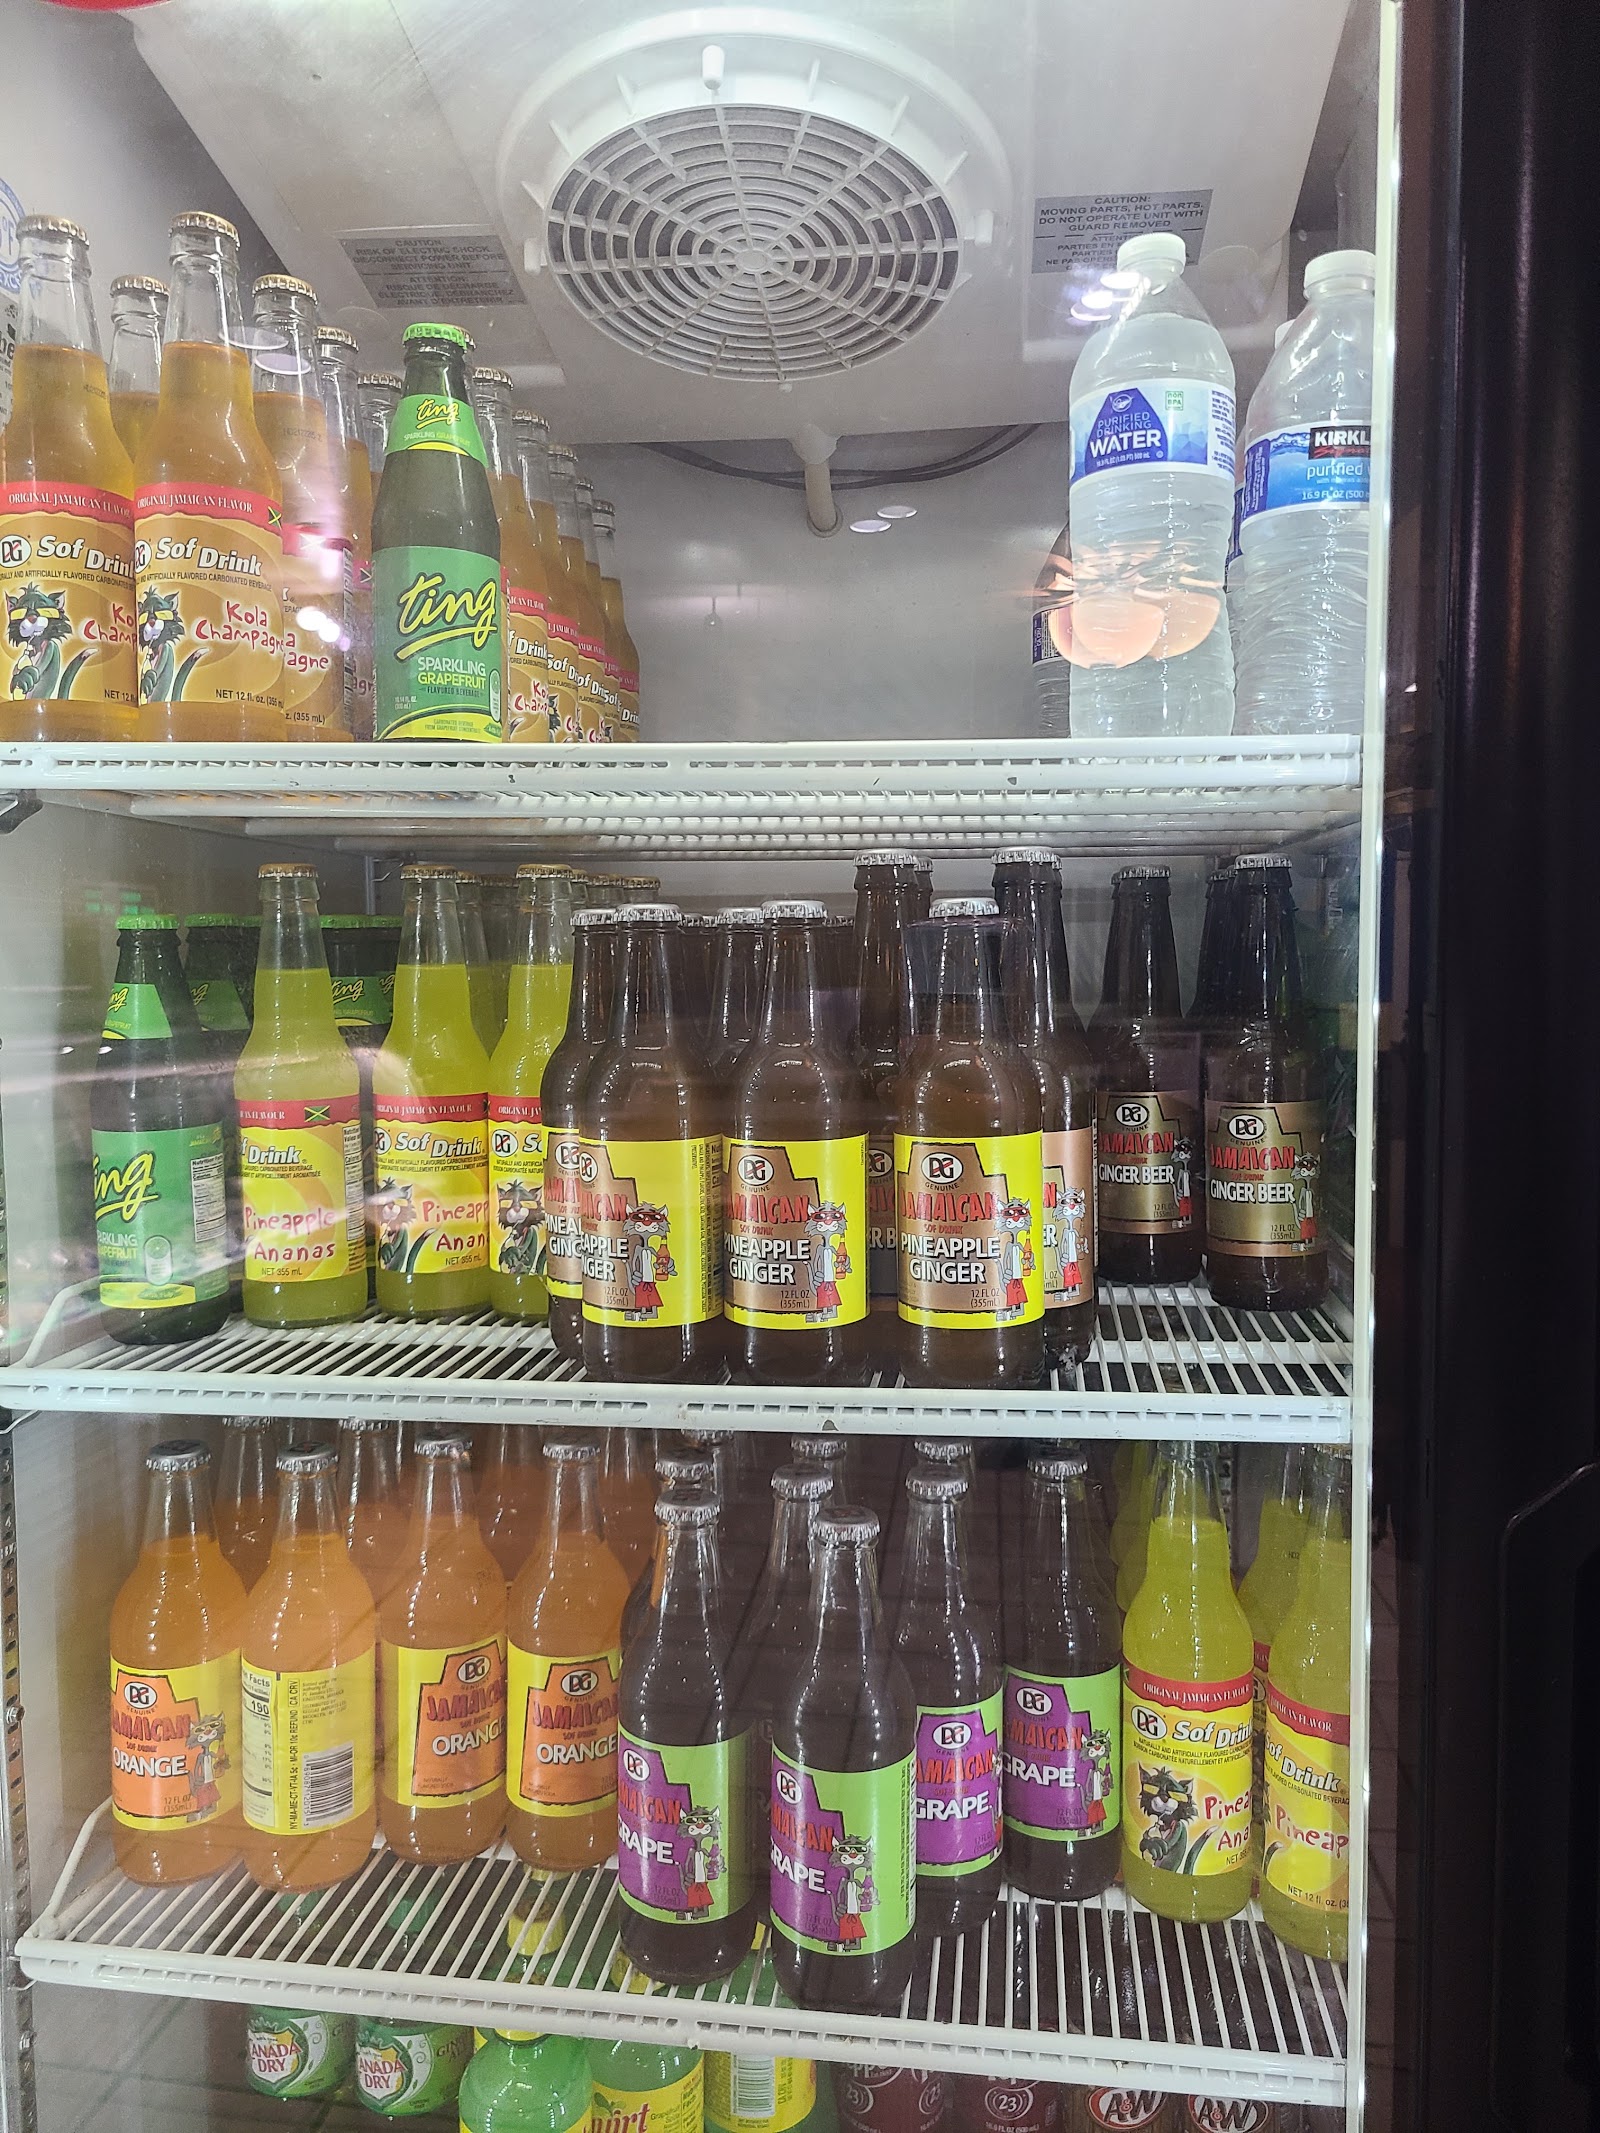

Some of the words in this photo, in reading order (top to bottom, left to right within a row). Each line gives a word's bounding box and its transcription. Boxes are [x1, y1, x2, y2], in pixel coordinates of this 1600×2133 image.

[1041, 207, 1087, 216] MOVING
[1134, 203, 1158, 212] HOT
[1095, 196, 1151, 205] CAUTION:
[1039, 217, 1056, 225] DO
[1059, 216, 1082, 224] NOT
[1086, 213, 1140, 222] OPERATE
[1144, 211, 1171, 220] UNIT
[1174, 209, 1203, 218] WITH
[1068, 223, 1110, 232] GUARD
[1113, 220, 1171, 230] REMOVED
[416, 398, 460, 428] ting
[1098, 412, 1150, 428] PURIFIED
[1096, 421, 1152, 438] DRINKING
[1089, 428, 1162, 459] WATER
[1306, 461, 1363, 481] purified
[9, 492, 51, 505] ORIGINAL
[53, 494, 101, 509] JAMAICAN
[169, 493, 217, 508] JAMAICAN
[218, 497, 254, 514] FLAVOR
[1302, 491, 1320, 500] 16.9
[37, 535, 86, 560] Sof
[155, 536, 199, 561] Sof
[198, 547, 262, 577] Drink
[25, 570, 62, 579] ARTIFICIALLY
[63, 571, 96, 583] FLAVORED
[177, 572, 208, 581] FLAVORED
[208, 573, 248, 586] CARBONATED
[226, 600, 268, 628] Kola
[396, 572, 498, 653] ting
[417, 656, 487, 677] SPARKLING
[417, 672, 487, 690] GRAPEFRUIT
[104, 688, 120, 700] NET
[215, 688, 233, 700] NET
[236, 691, 246, 702] 12
[401, 1105, 438, 1116] JAMAICAN
[440, 1104, 473, 1114] FLAVOUR
[498, 1105, 530, 1115] ORIGINAL
[1120, 1106, 1142, 1122] DG
[1234, 1118, 1257, 1136] DG
[395, 1131, 431, 1151] Sof
[431, 1137, 483, 1158] Drink
[494, 1133, 512, 1153] DG
[1230, 1137, 1265, 1146] GENUINE
[248, 1146, 303, 1165] Drink
[743, 1160, 766, 1181] DG
[928, 1156, 954, 1180] DG
[1099, 1164, 1140, 1184] GINGER
[1141, 1165, 1175, 1184] BEER
[924, 1182, 960, 1192] GENUINE
[1210, 1181, 1256, 1204] GINGER
[1257, 1182, 1296, 1204] BEER
[244, 1206, 336, 1236] Pineapple
[923, 1223, 937, 1234] SOF
[938, 1225, 964, 1235] DRINK
[1270, 1223, 1278, 1232] 12
[1278, 1223, 1286, 1232] FL
[1286, 1223, 1295, 1232] OZ
[752, 1226, 774, 1236] DRINK
[1270, 1231, 1296, 1240] (355mL)
[254, 1241, 336, 1263] Ananas
[901, 1233, 1001, 1261] PINEAPPLE
[445, 1257, 460, 1266] NET
[461, 1256, 473, 1264] 355
[729, 1256, 796, 1285] GINGER
[261, 1267, 276, 1276] NET
[276, 1267, 290, 1276] 355
[909, 1259, 987, 1285] GINGER
[611, 1287, 619, 1296] FL
[619, 1287, 629, 1297] OZ
[780, 1289, 789, 1299] 12
[790, 1289, 800, 1299] FL
[801, 1289, 810, 1299] OZ
[970, 1288, 980, 1298] 12
[981, 1288, 990, 1298] FL
[991, 1288, 1000, 1298] OZ
[780, 1299, 810, 1309] (355mL)
[465, 1658, 486, 1681] DG
[249, 1674, 271, 1688] Facts
[289, 1680, 299, 1695] CRV
[568, 1673, 592, 1693] DG
[129, 1685, 150, 1706] DG
[289, 1695, 299, 1706] CA
[1023, 1690, 1045, 1712] DG
[1143, 1682, 1180, 1700] ORIGINAL
[1182, 1692, 1222, 1704] JAMAICAN
[1223, 1684, 1250, 1701] FLAVOUR
[251, 1699, 270, 1715] 190
[289, 1710, 299, 1735] REFUND
[1136, 1708, 1158, 1737] DG
[1172, 1720, 1216, 1743] Sof
[1298, 1712, 1332, 1732] FLAVOR
[941, 1726, 965, 1745] DG
[536, 1732, 617, 1765] ORANGE
[1139, 1737, 1161, 1750] NATURALLY
[1161, 1746, 1171, 1754] AND
[1172, 1748, 1203, 1758] ARTIFICIALLY
[113, 1747, 186, 1778] ORANGE
[626, 1752, 645, 1779] DG
[1003, 1752, 1076, 1788] GRAPE
[1178, 1757, 1218, 1766] NATURELLEMENT
[1217, 1757, 1224, 1765] ET
[1281, 1755, 1342, 1792] Drink
[780, 1773, 797, 1801] DG
[1287, 1783, 1322, 1802] CARBONATED
[164, 1796, 172, 1805] 12
[173, 1796, 181, 1805] FL
[1225, 1854, 1238, 1866] NET
[1287, 1883, 1303, 1898] NET
[1304, 1888, 1314, 1901] 12
[1325, 1897, 1337, 1907] oz.
[258, 2058, 286, 2073] DRY
[364, 2073, 391, 2089] DRY
[998, 2094, 1017, 2113] 23
[1103, 2090, 1167, 2123] A&W
[1200, 2097, 1256, 2132] A&W
